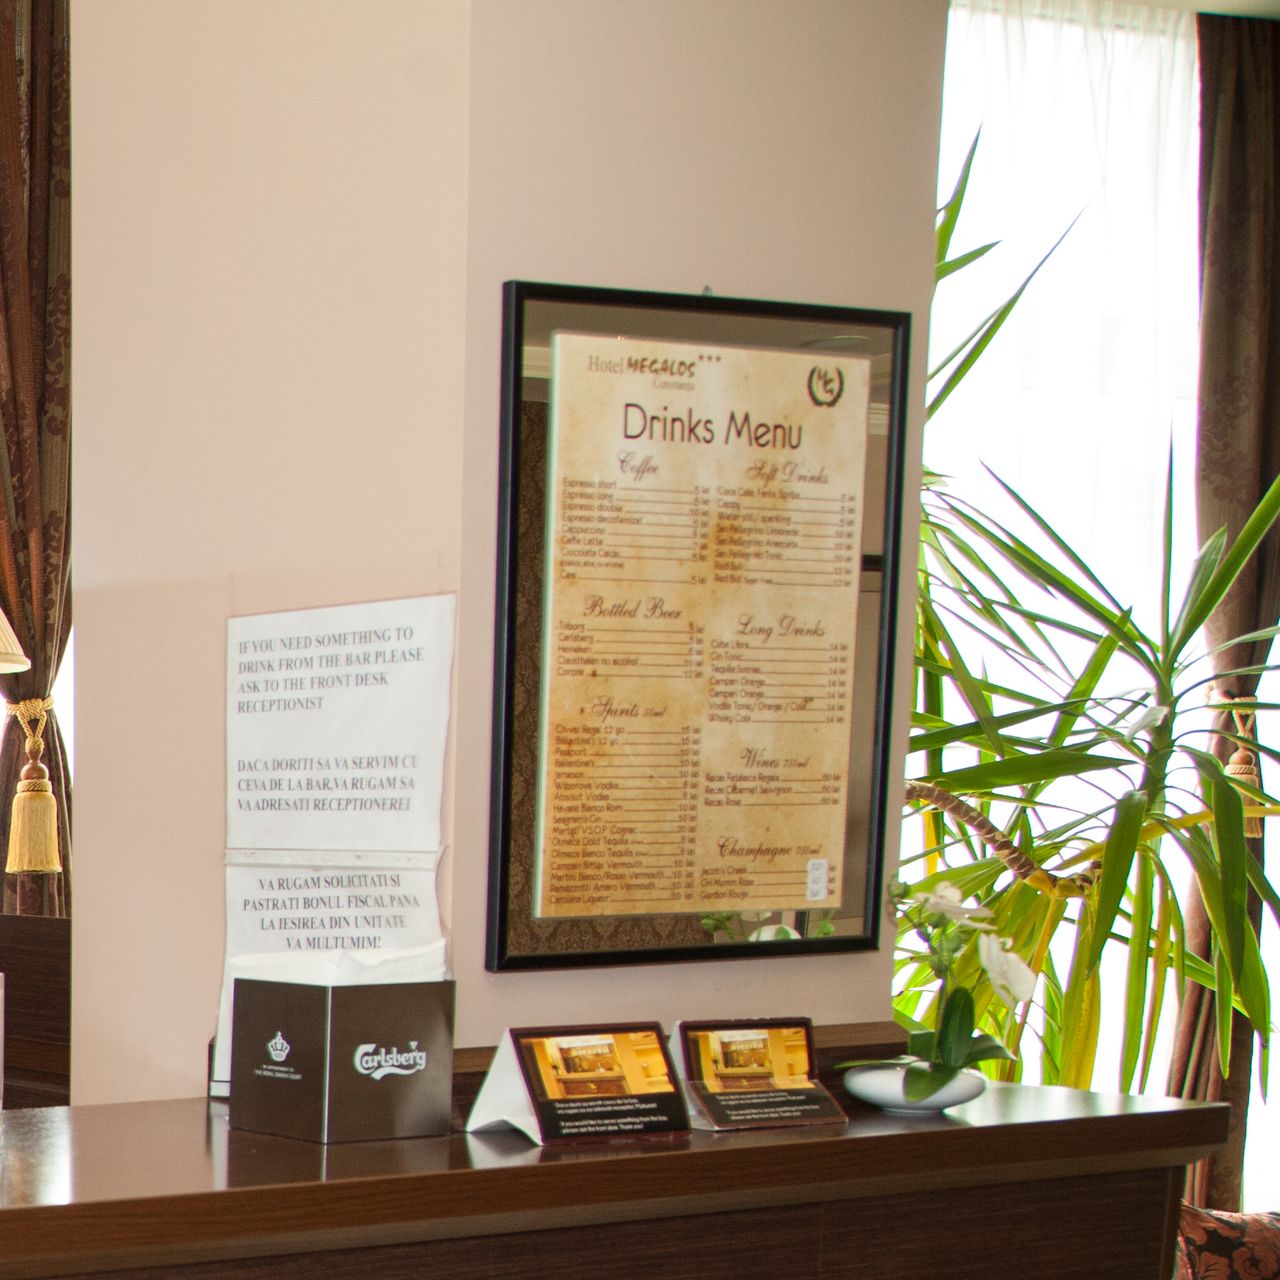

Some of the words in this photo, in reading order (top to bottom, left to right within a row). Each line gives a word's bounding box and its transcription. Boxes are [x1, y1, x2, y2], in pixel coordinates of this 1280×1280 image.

[588, 355, 624, 374] Hotel
[627, 357, 696, 378] MEGALOS
[623, 403, 714, 444] Drinks
[725, 411, 802, 449] Menu
[618, 450, 658, 482] Coffee
[747, 459, 779, 487] Soft
[782, 461, 829, 485] Drinks
[584, 595, 641, 618] Bottled
[645, 596, 682, 619] Beer
[239, 641, 252, 655] IF
[252, 639, 276, 654] YOU
[279, 636, 312, 651] NEED
[315, 628, 391, 649] SOMETHING
[395, 626, 414, 640] TO
[736, 615, 773, 644] Long
[778, 615, 825, 637] Drinks
[238, 660, 276, 674] DRINK
[278, 656, 314, 672] FROM
[317, 655, 340, 669] THE
[345, 652, 372, 667] BAR
[375, 647, 425, 665] PLEASE
[238, 680, 261, 694] ASK
[263, 679, 280, 693] TO
[282, 677, 306, 691] THE
[310, 674, 353, 689] FRONT
[355, 672, 389, 686] DESK
[238, 696, 324, 714] RECEPTIONIST
[592, 696, 639, 723] Spirits
[238, 758, 269, 772] DACA
[272, 757, 314, 771] DORITI
[316, 758, 332, 770] SA
[334, 756, 349, 770] VA
[352, 755, 398, 769] SERVIM
[741, 748, 779, 768] Wines
[238, 778, 267, 792] CEVA
[270, 778, 284, 791] DE
[288, 778, 303, 791] LA
[351, 776, 397, 791] RUGAM
[400, 776, 415, 790] SA
[238, 799, 252, 812] VA
[253, 798, 310, 811] ADRESATI
[313, 797, 411, 812] RECEPTIONEREI
[718, 836, 792, 864] Champagne
[259, 878, 274, 891] VA
[278, 876, 321, 890] RUGAM
[324, 874, 387, 889] SOLICITATI
[390, 874, 400, 887] SI
[243, 897, 300, 911] PASTRATI
[303, 896, 344, 910] BONUL
[347, 895, 387, 908] FISCAL
[389, 894, 421, 908] PANA
[261, 918, 275, 930] LA
[279, 916, 326, 930] IESIREA
[329, 916, 350, 929] DIN
[354, 915, 406, 928] UNITATE
[286, 937, 302, 950] VA
[306, 936, 381, 950] MULTUMIM!
[353, 1042, 426, 1079] Carlsberg
